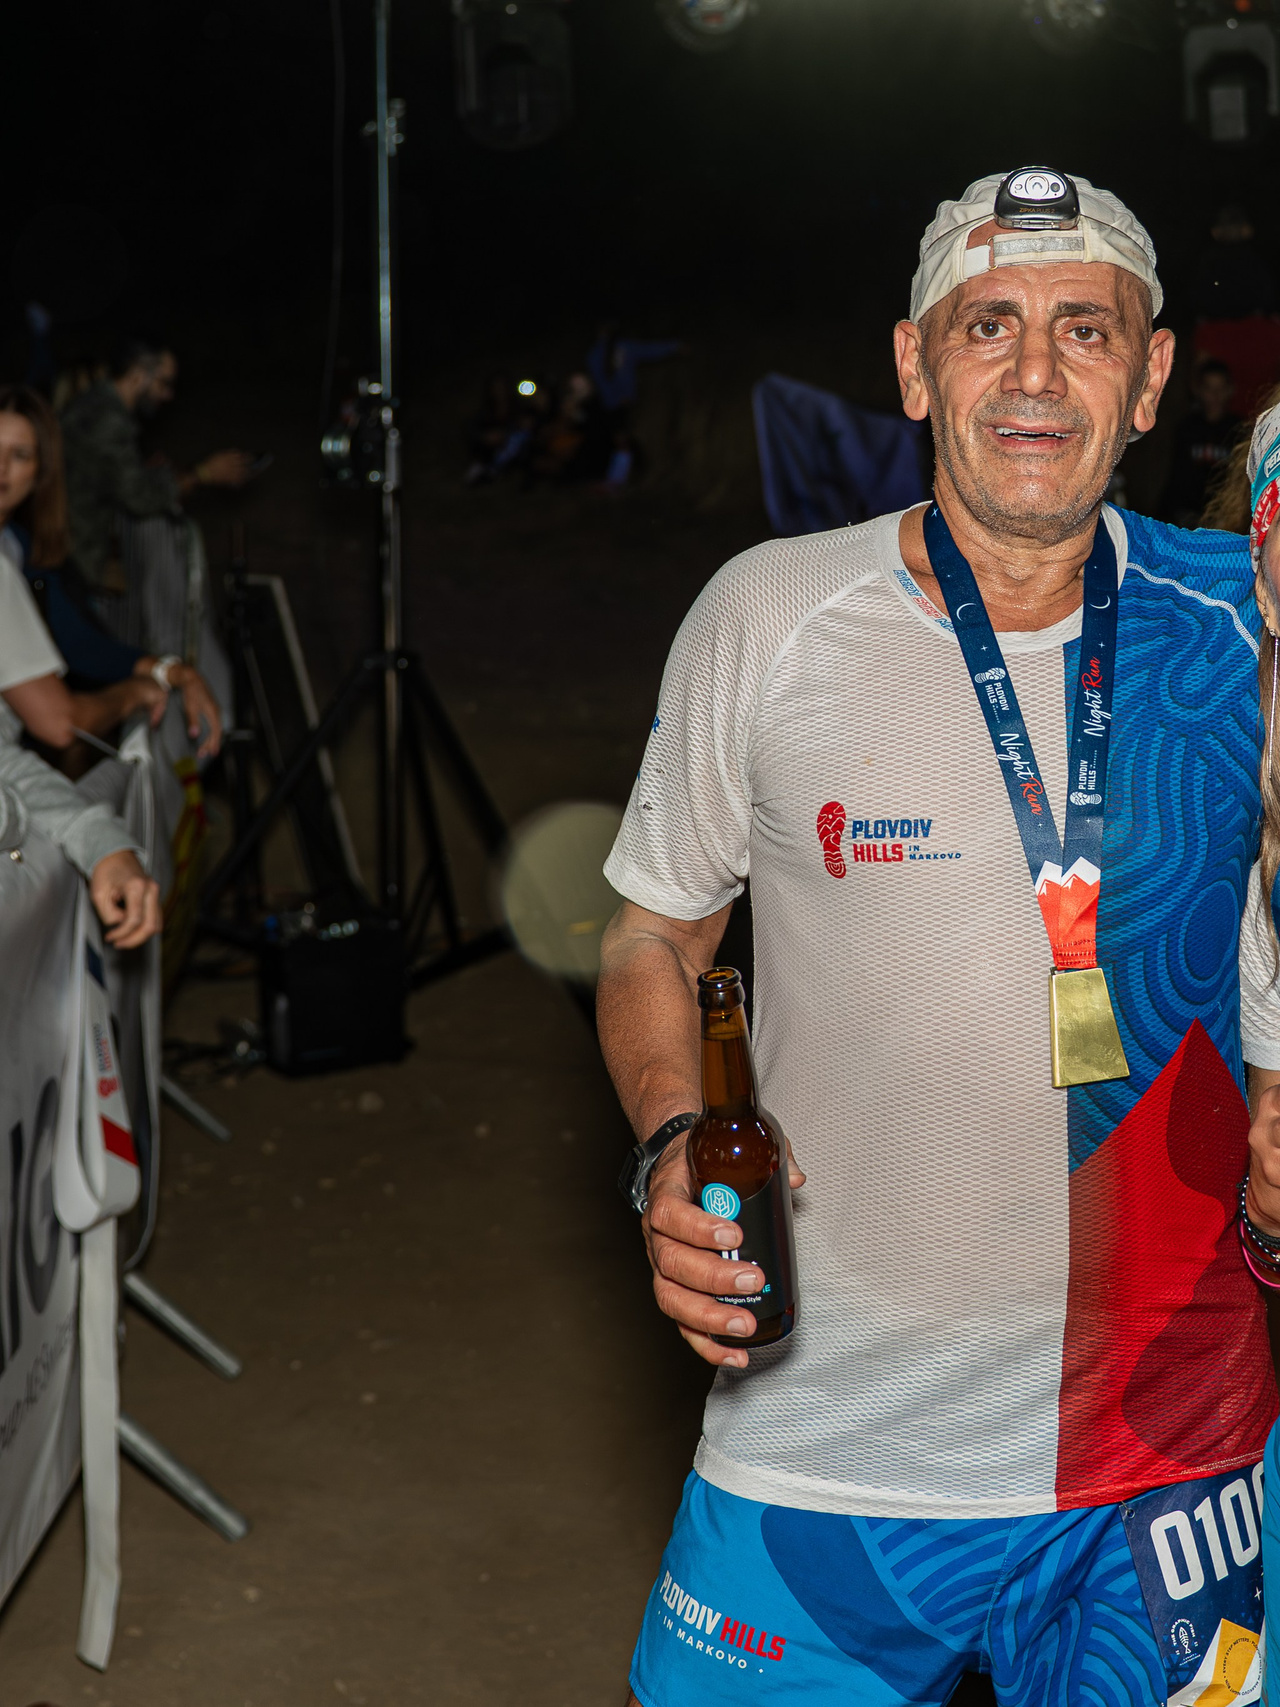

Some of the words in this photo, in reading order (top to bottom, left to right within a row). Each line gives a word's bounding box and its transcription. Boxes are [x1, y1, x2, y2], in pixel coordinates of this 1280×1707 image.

[893, 569, 922, 597] EVERY
[912, 596, 943, 619] STEP
[1081, 656, 1103, 691] Run
[985, 684, 998, 704] HILLS
[993, 682, 1010, 711] PLOVDIV
[1082, 688, 1112, 738] Night
[997, 733, 1035, 781] Night
[1020, 777, 1044, 816] Run
[1078, 759, 1089, 790] PLOVDIV
[1087, 770, 1097, 790] HILLS
[851, 819, 933, 839] PLOVDIV
[852, 843, 904, 862] HILLS
[909, 852, 962, 860] MARKOVO
[724, 1297, 746, 1305] Belgian
[746, 1296, 762, 1304] Style
[660, 1570, 722, 1636] PLOVDIV
[719, 1616, 787, 1662] HILLS
[663, 1616, 674, 1631] IN
[677, 1628, 748, 1669] MARKOVO
